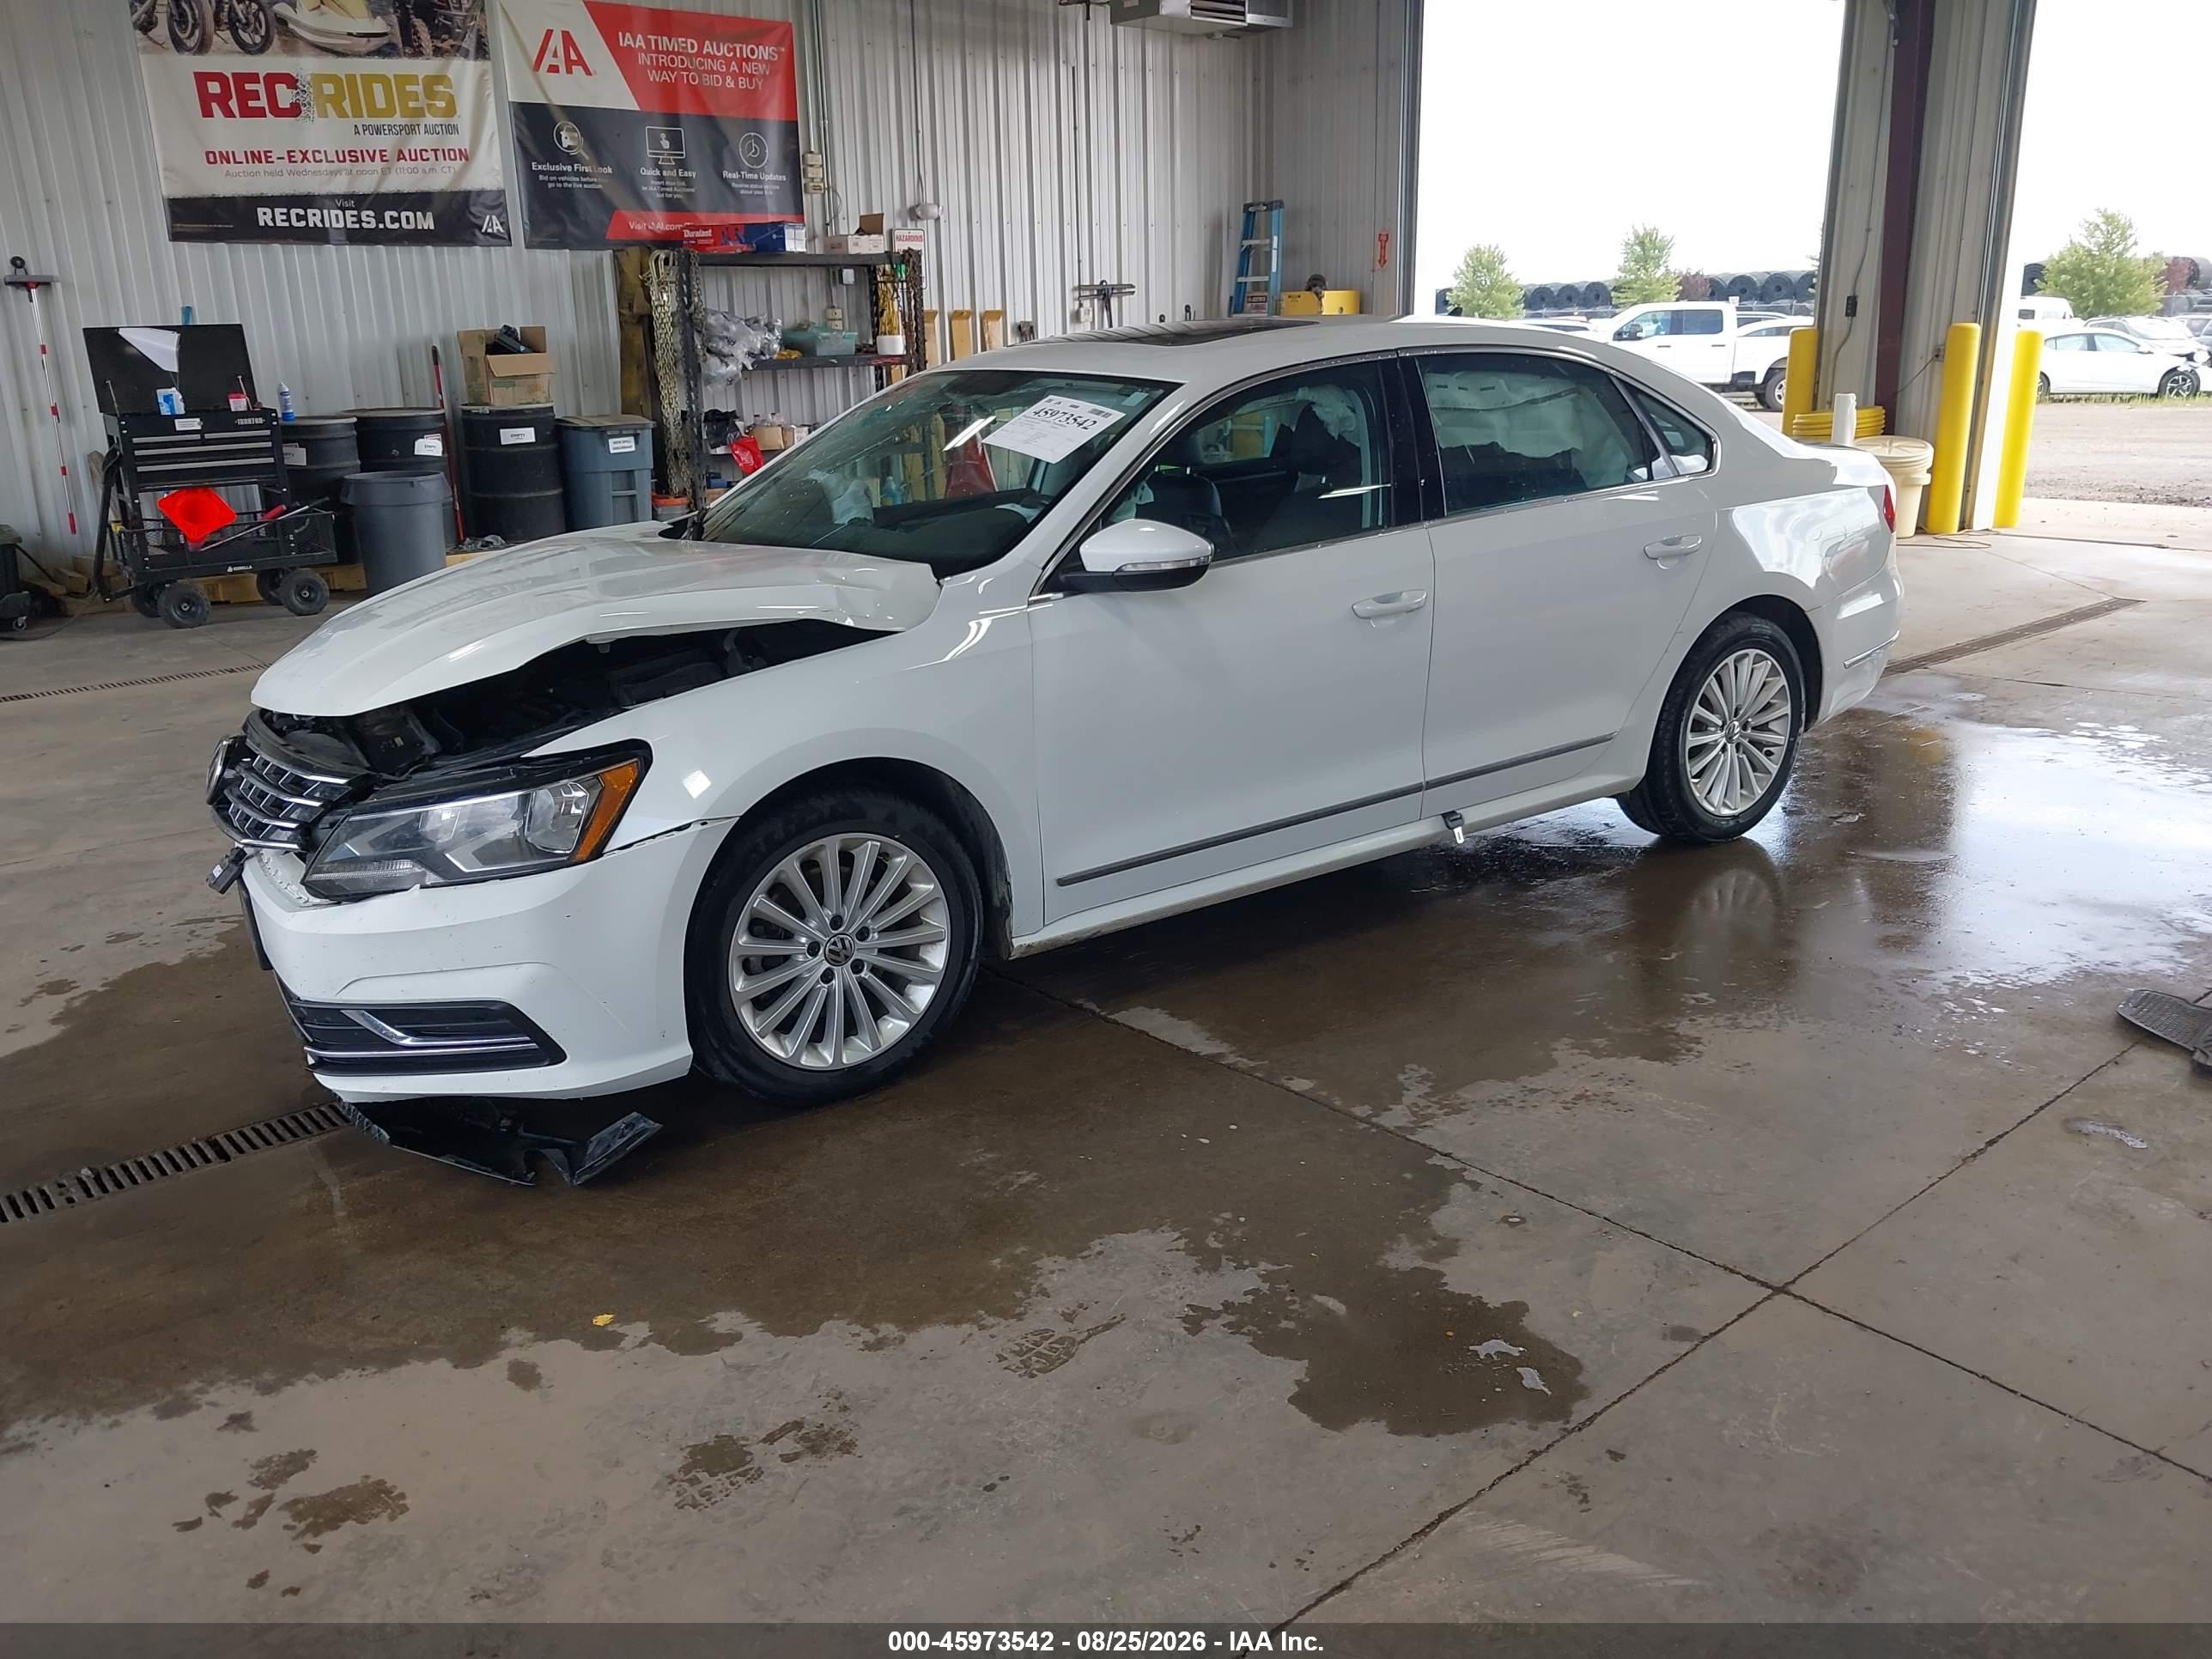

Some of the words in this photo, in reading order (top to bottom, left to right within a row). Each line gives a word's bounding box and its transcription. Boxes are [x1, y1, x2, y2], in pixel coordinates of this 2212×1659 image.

[617, 32, 646, 49] IAA
[647, 35, 698, 54] TIMED
[638, 52, 726, 72] INTRODUCING
[729, 62, 739, 74] A
[742, 63, 770, 76] NEW
[647, 70, 678, 83] WAY
[680, 71, 699, 85] TO
[702, 75, 723, 87] BID
[726, 76, 735, 88] &
[738, 76, 763, 90] BUY
[192, 71, 302, 118] REC
[310, 73, 458, 118] RIDES
[354, 125, 361, 136] A
[362, 124, 421, 136] POWERSPORT
[423, 123, 459, 136] AUCTION
[204, 149, 390, 164] ONLINE-EXCLUSIVE
[396, 148, 470, 162] AUCTION
[532, 161, 572, 172] Exclusive
[640, 167, 660, 176] Quick
[678, 168, 696, 179] Easy
[722, 170, 758, 179] Real-Time
[759, 172, 787, 182] Updates
[335, 199, 356, 208] Visit
[258, 208, 435, 230] RECRIDES.COM
[683, 228, 712, 238] Duralast
[1032, 408, 1097, 430] 45973542
